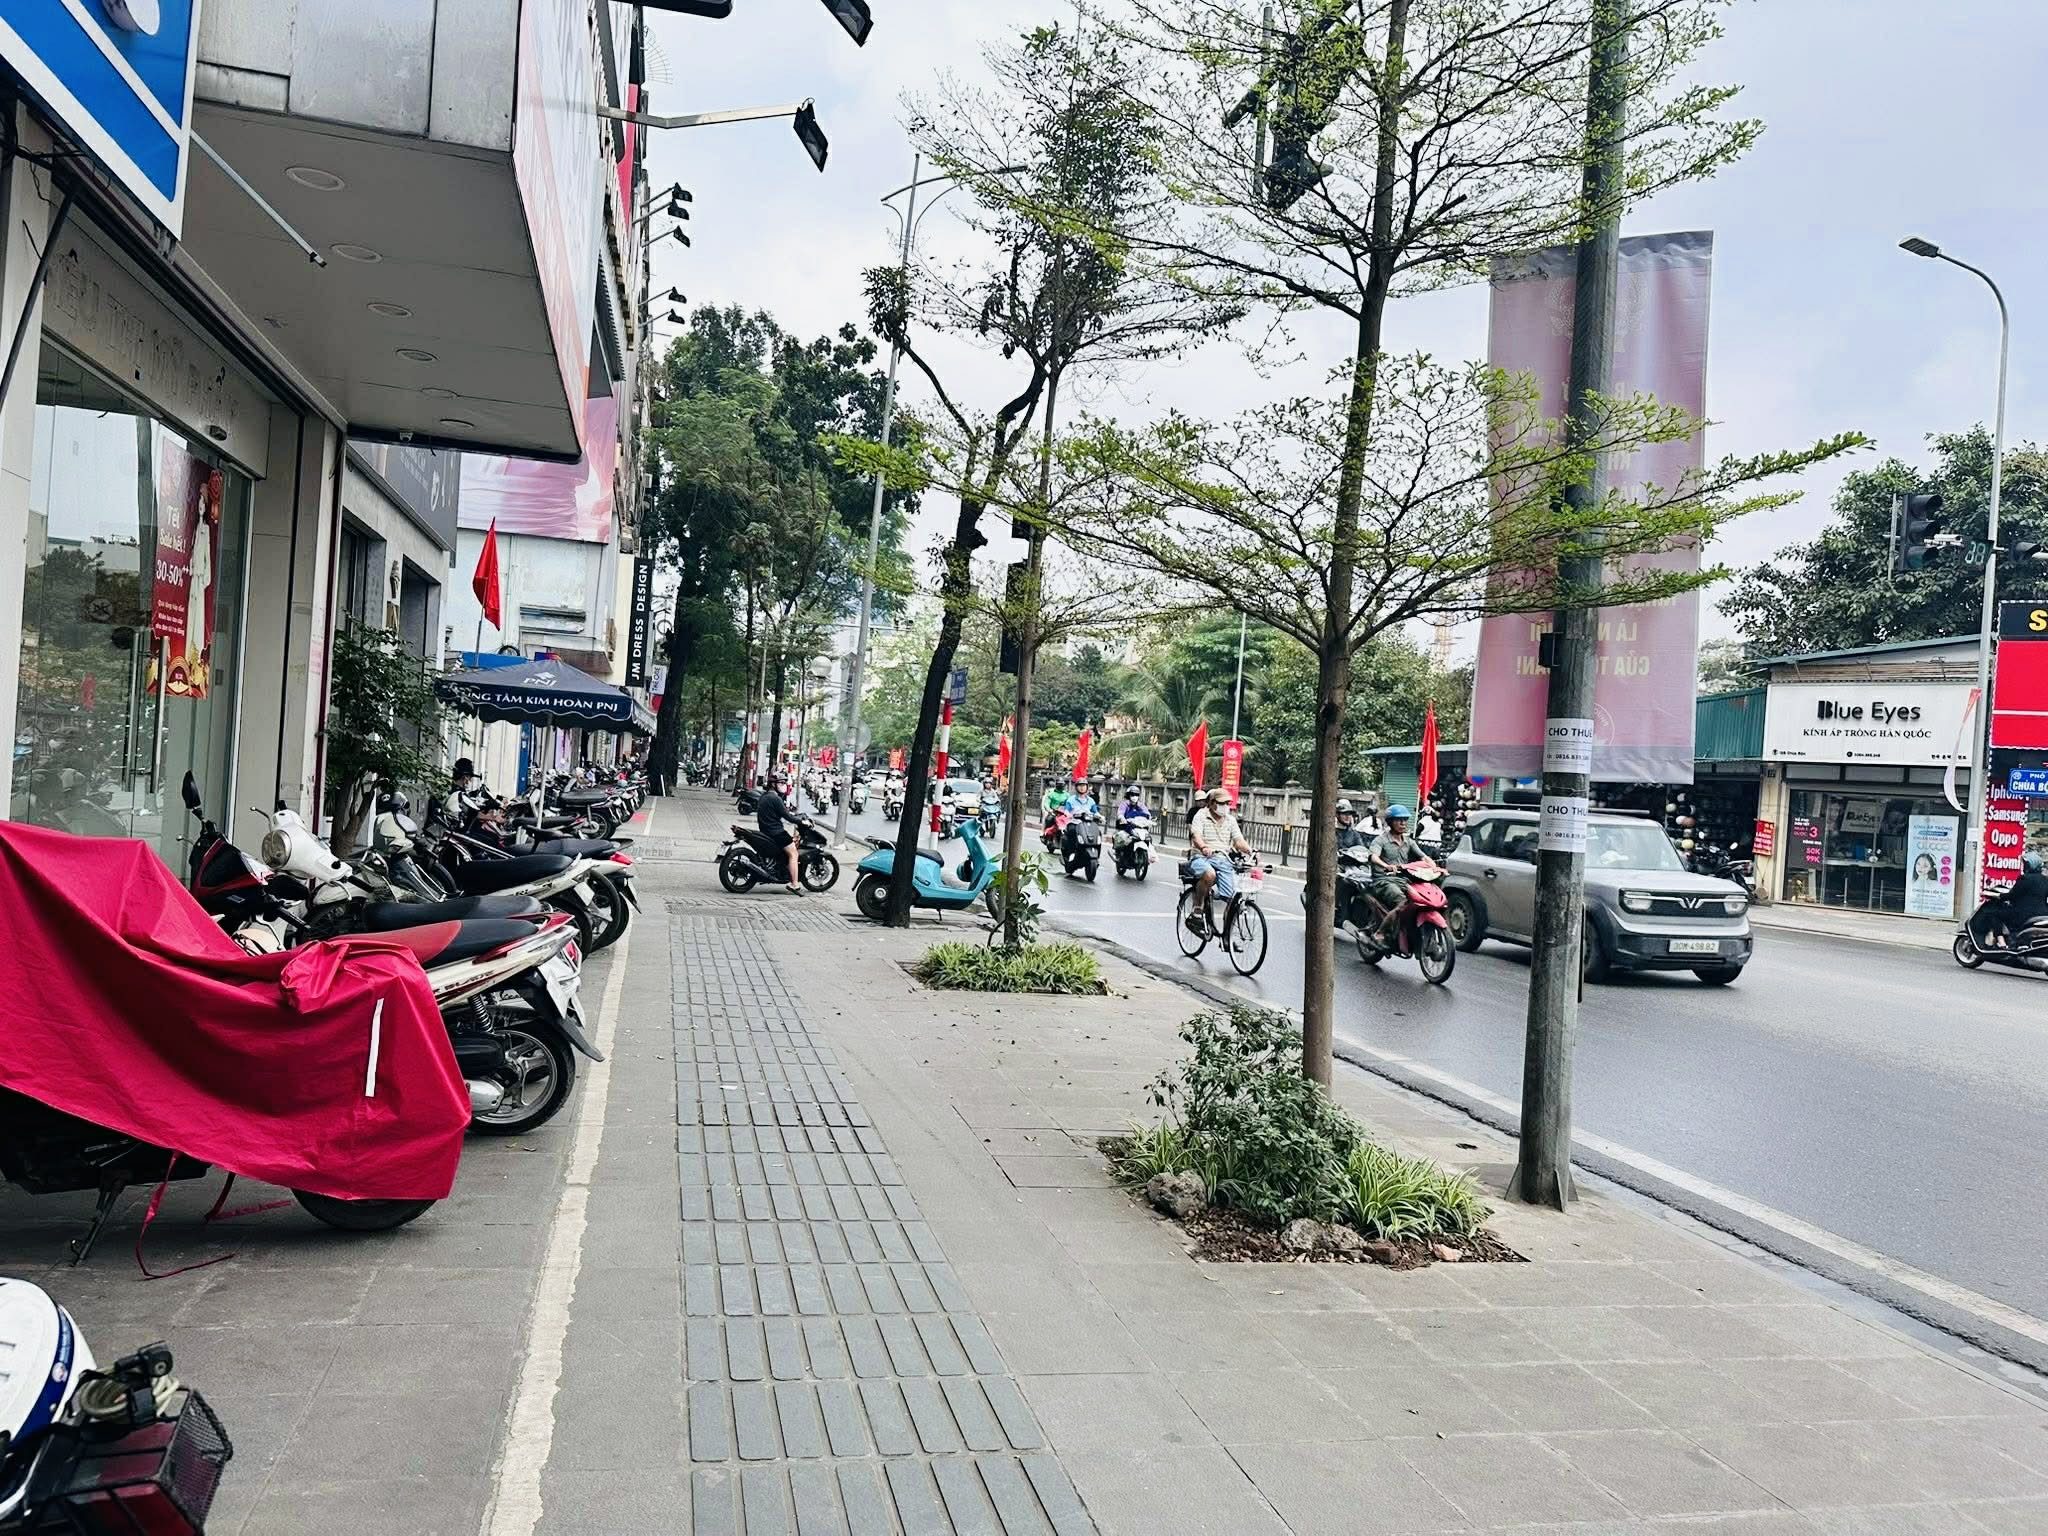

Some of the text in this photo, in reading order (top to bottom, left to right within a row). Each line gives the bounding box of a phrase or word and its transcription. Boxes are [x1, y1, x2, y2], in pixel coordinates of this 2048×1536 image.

[631, 564, 648, 681] JM DRESS DESIGN
[522, 677, 558, 687] PNJ
[495, 692, 522, 704] TÂM
[526, 696, 550, 706] KIM
[553, 697, 594, 709] HOÀN
[596, 702, 618, 712] PNJ
[1817, 700, 1921, 725] Blue Eyes
[1548, 727, 1568, 737] CHO
[1803, 728, 1828, 737] KÍNH
[1830, 728, 1842, 737] ÁP
[1903, 728, 1932, 739] QUỐC
[2012, 779, 2036, 791] CHÙA
[1547, 805, 1569, 815] CHO
[1988, 805, 2026, 826] Samsung
[1809, 826, 1818, 838] 3
[1991, 828, 2018, 847] Oppo
